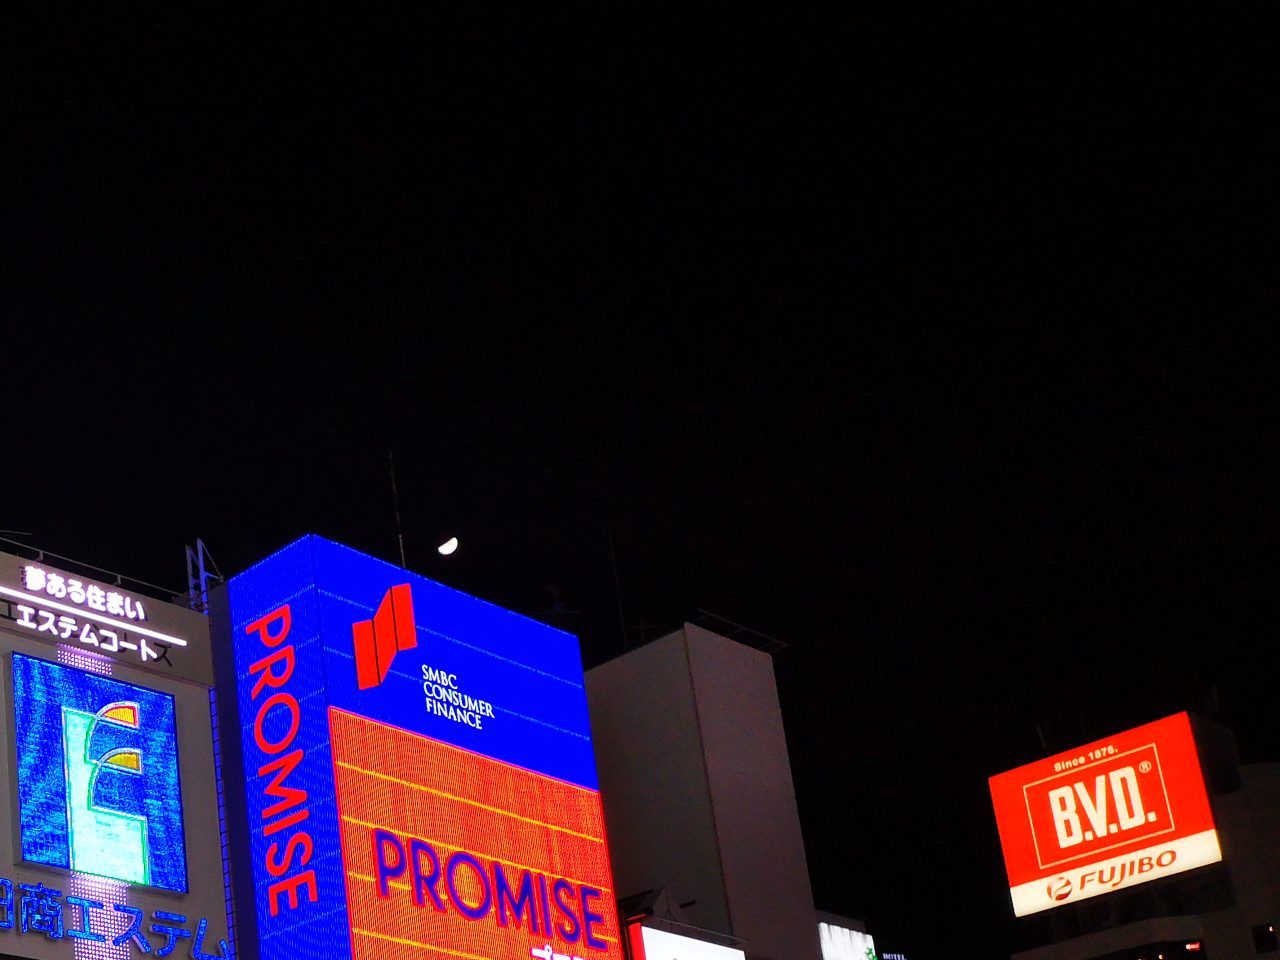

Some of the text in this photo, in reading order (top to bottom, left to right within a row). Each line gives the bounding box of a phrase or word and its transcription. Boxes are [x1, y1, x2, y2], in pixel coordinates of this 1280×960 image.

[24, 565, 147, 621] 夢ある住まい
[421, 664, 458, 691] SMBC
[423, 681, 495, 719] CONSUMER
[426, 697, 483, 730] FINANCE
[245, 603, 318, 917] PROMISE
[1053, 755, 1086, 773] Since
[1048, 765, 1157, 849] B.V.D.
[372, 828, 609, 951] PROMISE
[1080, 850, 1177, 891] FUJIBO
